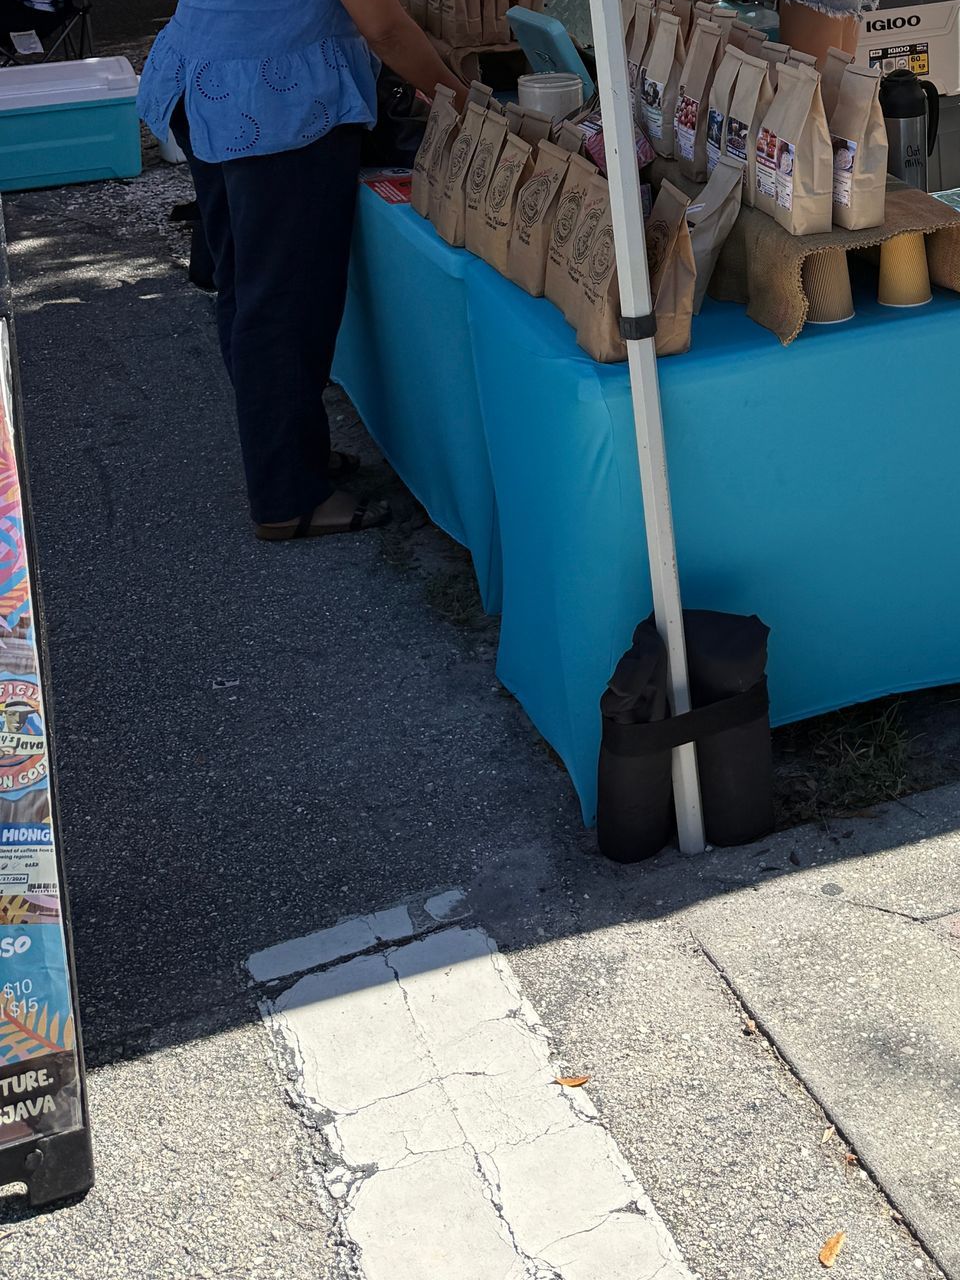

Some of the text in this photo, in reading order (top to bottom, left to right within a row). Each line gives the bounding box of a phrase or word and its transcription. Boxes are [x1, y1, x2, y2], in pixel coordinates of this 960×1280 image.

[866, 15, 921, 33] IGLOO
[906, 144, 921, 158] Oat
[15, 737, 44, 750] Java
[3, 979, 32, 998] $10
[10, 997, 38, 1018] $15
